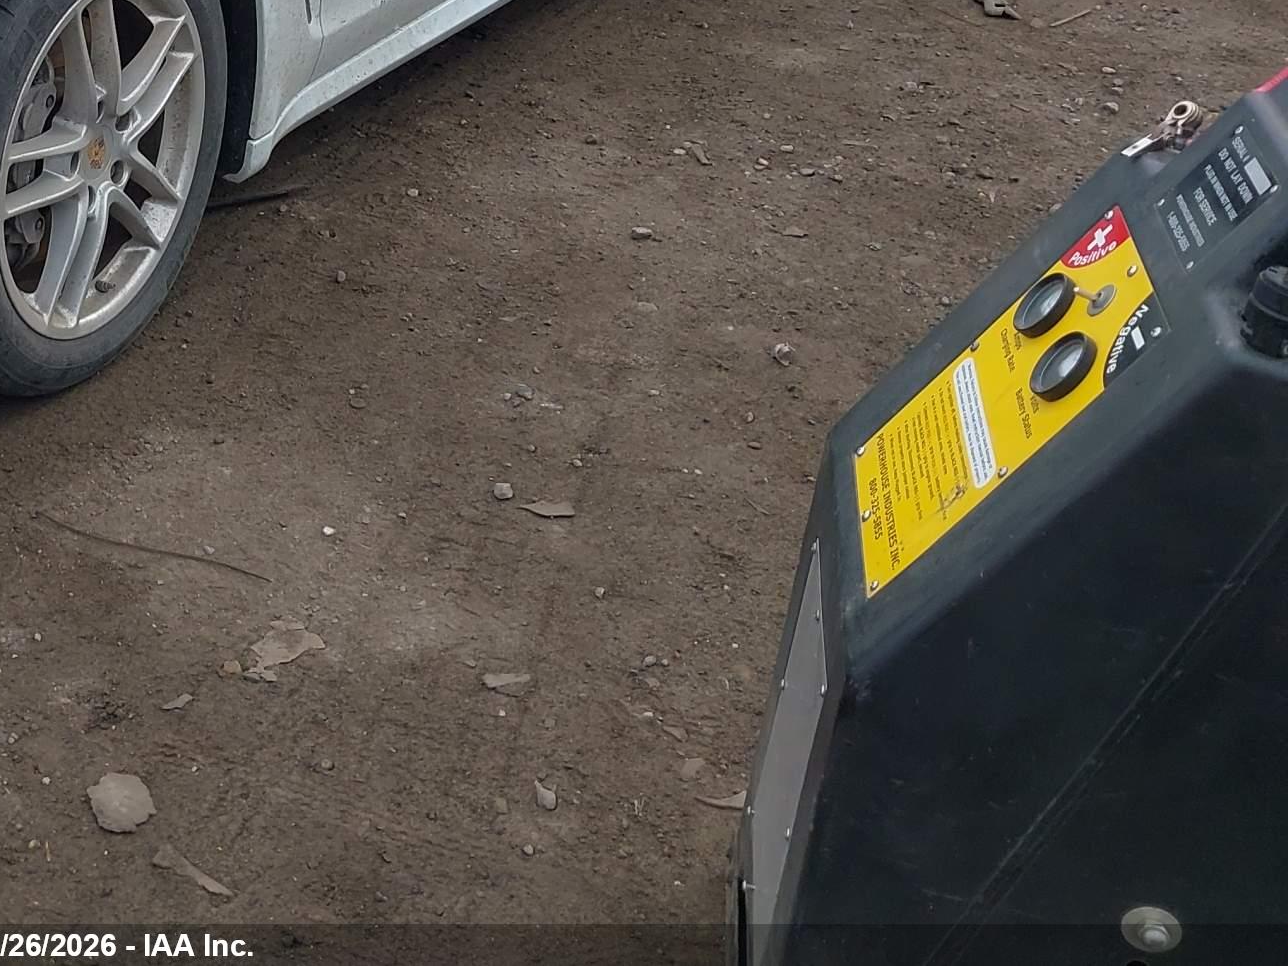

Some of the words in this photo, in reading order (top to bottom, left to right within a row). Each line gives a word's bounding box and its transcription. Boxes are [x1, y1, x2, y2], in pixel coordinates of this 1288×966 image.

[1218, 147, 1230, 161] DO
[1224, 157, 1237, 173] NOT
[1230, 170, 1244, 185] LAY
[1237, 182, 1253, 204] DOWN
[1193, 186, 1205, 203] FOR
[1199, 198, 1217, 226] SERVICE
[1068, 240, 1117, 266] Positive
[1000, 328, 1012, 359] Charging
[1007, 354, 1016, 373] Rate
[1106, 303, 1149, 374] Negative
[1015, 387, 1026, 416] Battery
[1022, 413, 1033, 439] Status
[876, 433, 890, 491] POWERHOUSE
[868, 478, 884, 540] 800-325-5855
[883, 491, 899, 548] INDUSTRIES
[889, 545, 902, 571] INC.
